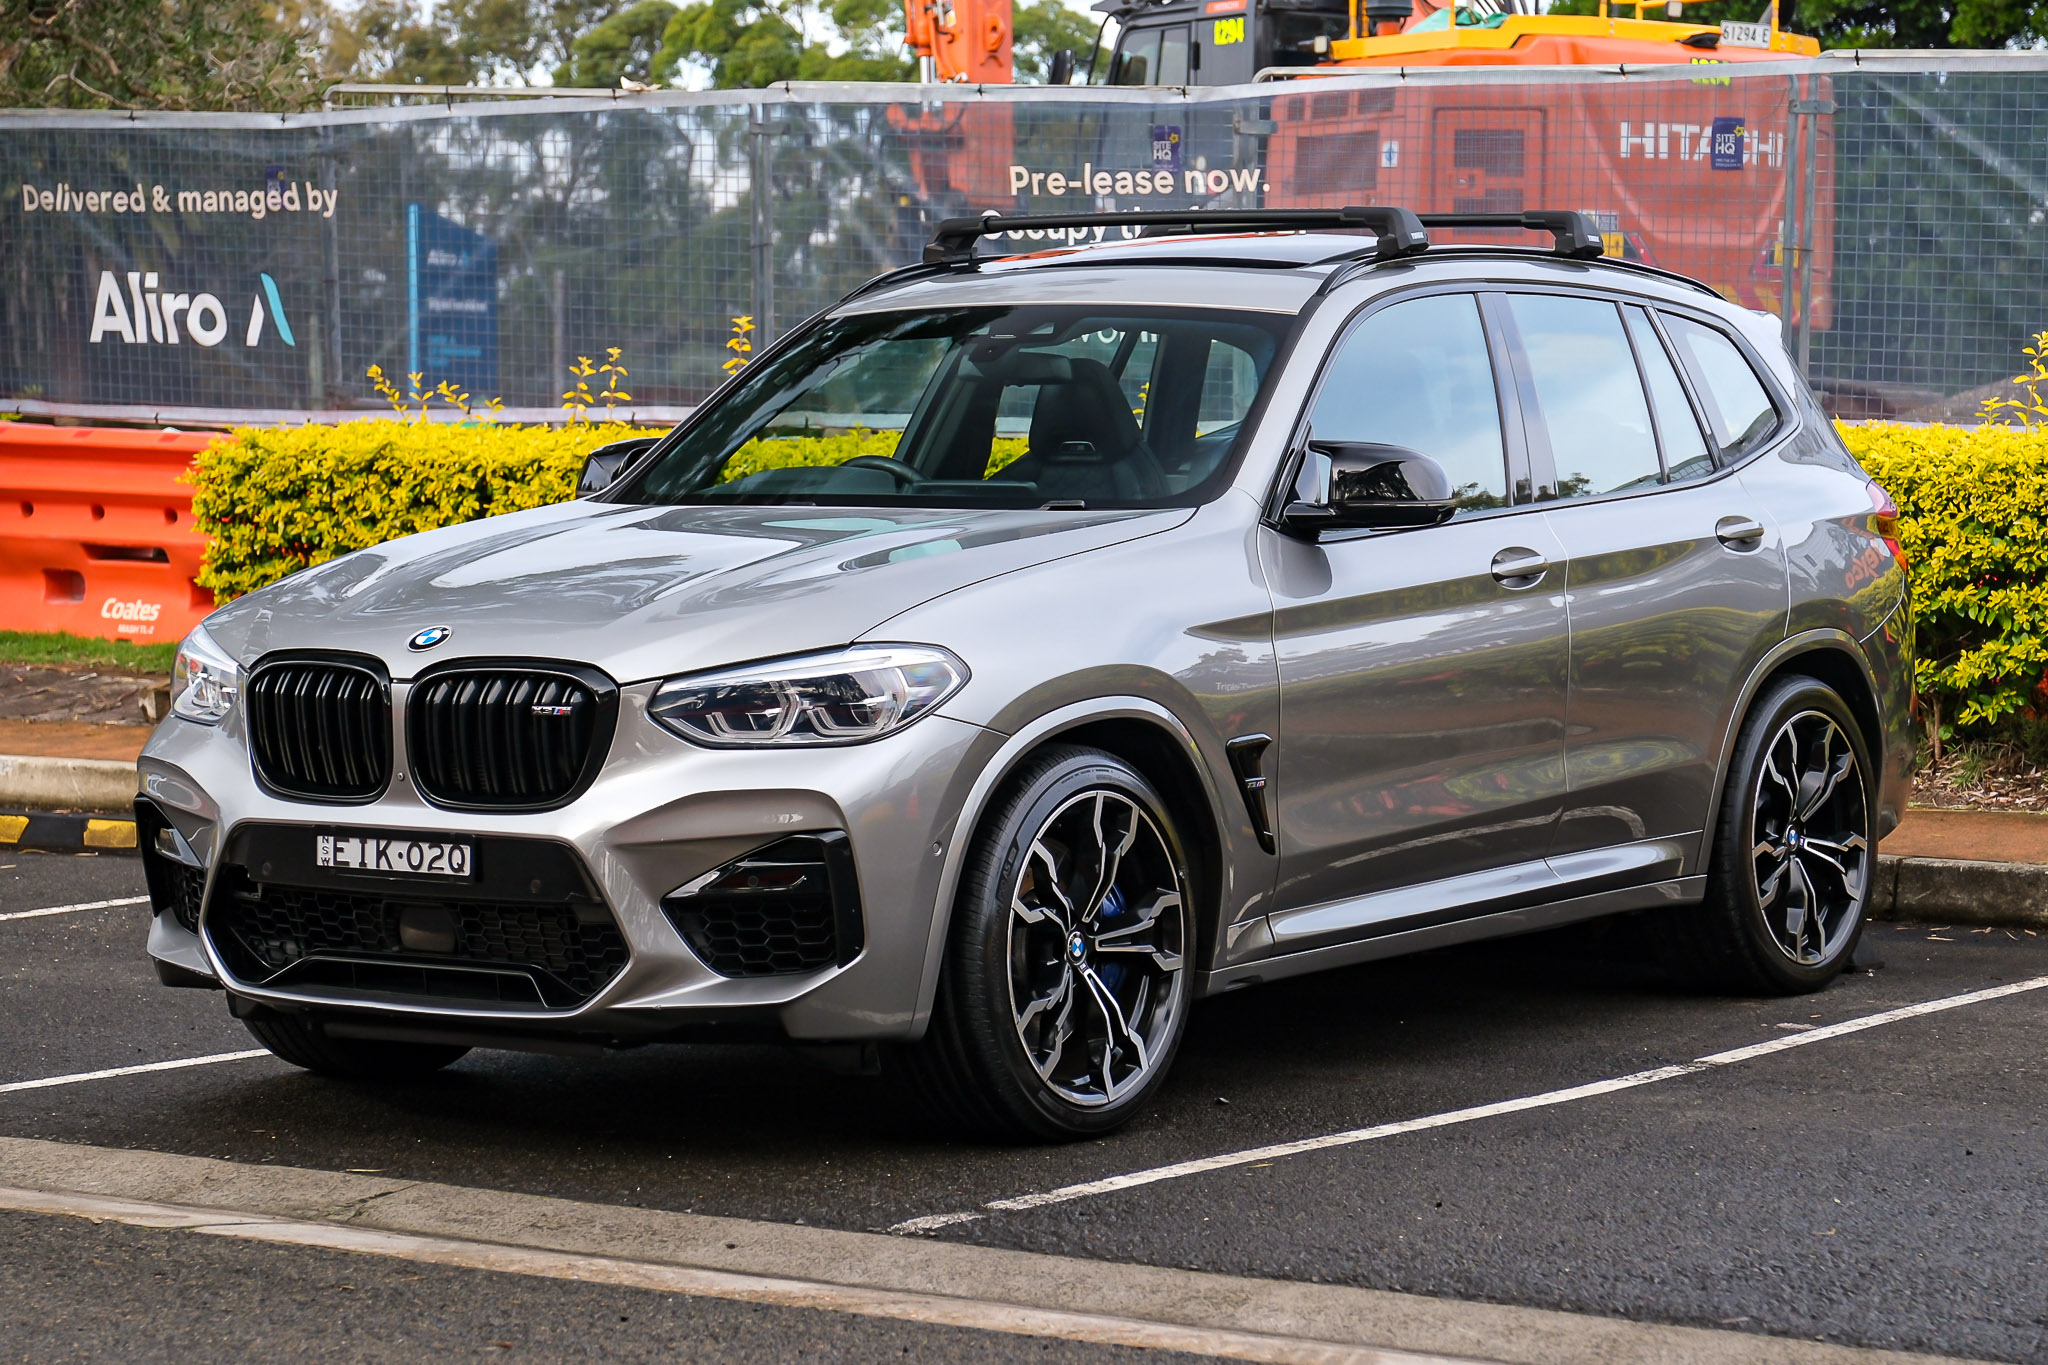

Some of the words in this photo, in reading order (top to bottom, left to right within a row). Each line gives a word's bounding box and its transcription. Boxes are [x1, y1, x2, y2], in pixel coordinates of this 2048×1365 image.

[1762, 28, 1769, 43] E
[1153, 141, 1172, 150] SITE
[1620, 121, 1784, 168] HITAHI
[1715, 133, 1736, 143] SITE
[1153, 150, 1172, 161] HQ
[1715, 143, 1736, 154] HQ
[1009, 162, 1175, 197] Pre-lease
[1184, 168, 1271, 195] now.
[22, 182, 147, 213] Delivered
[152, 184, 172, 213] &
[177, 181, 302, 221] managed
[305, 181, 338, 219] by
[89, 269, 228, 348] Aliro
[101, 597, 161, 622] Coates
